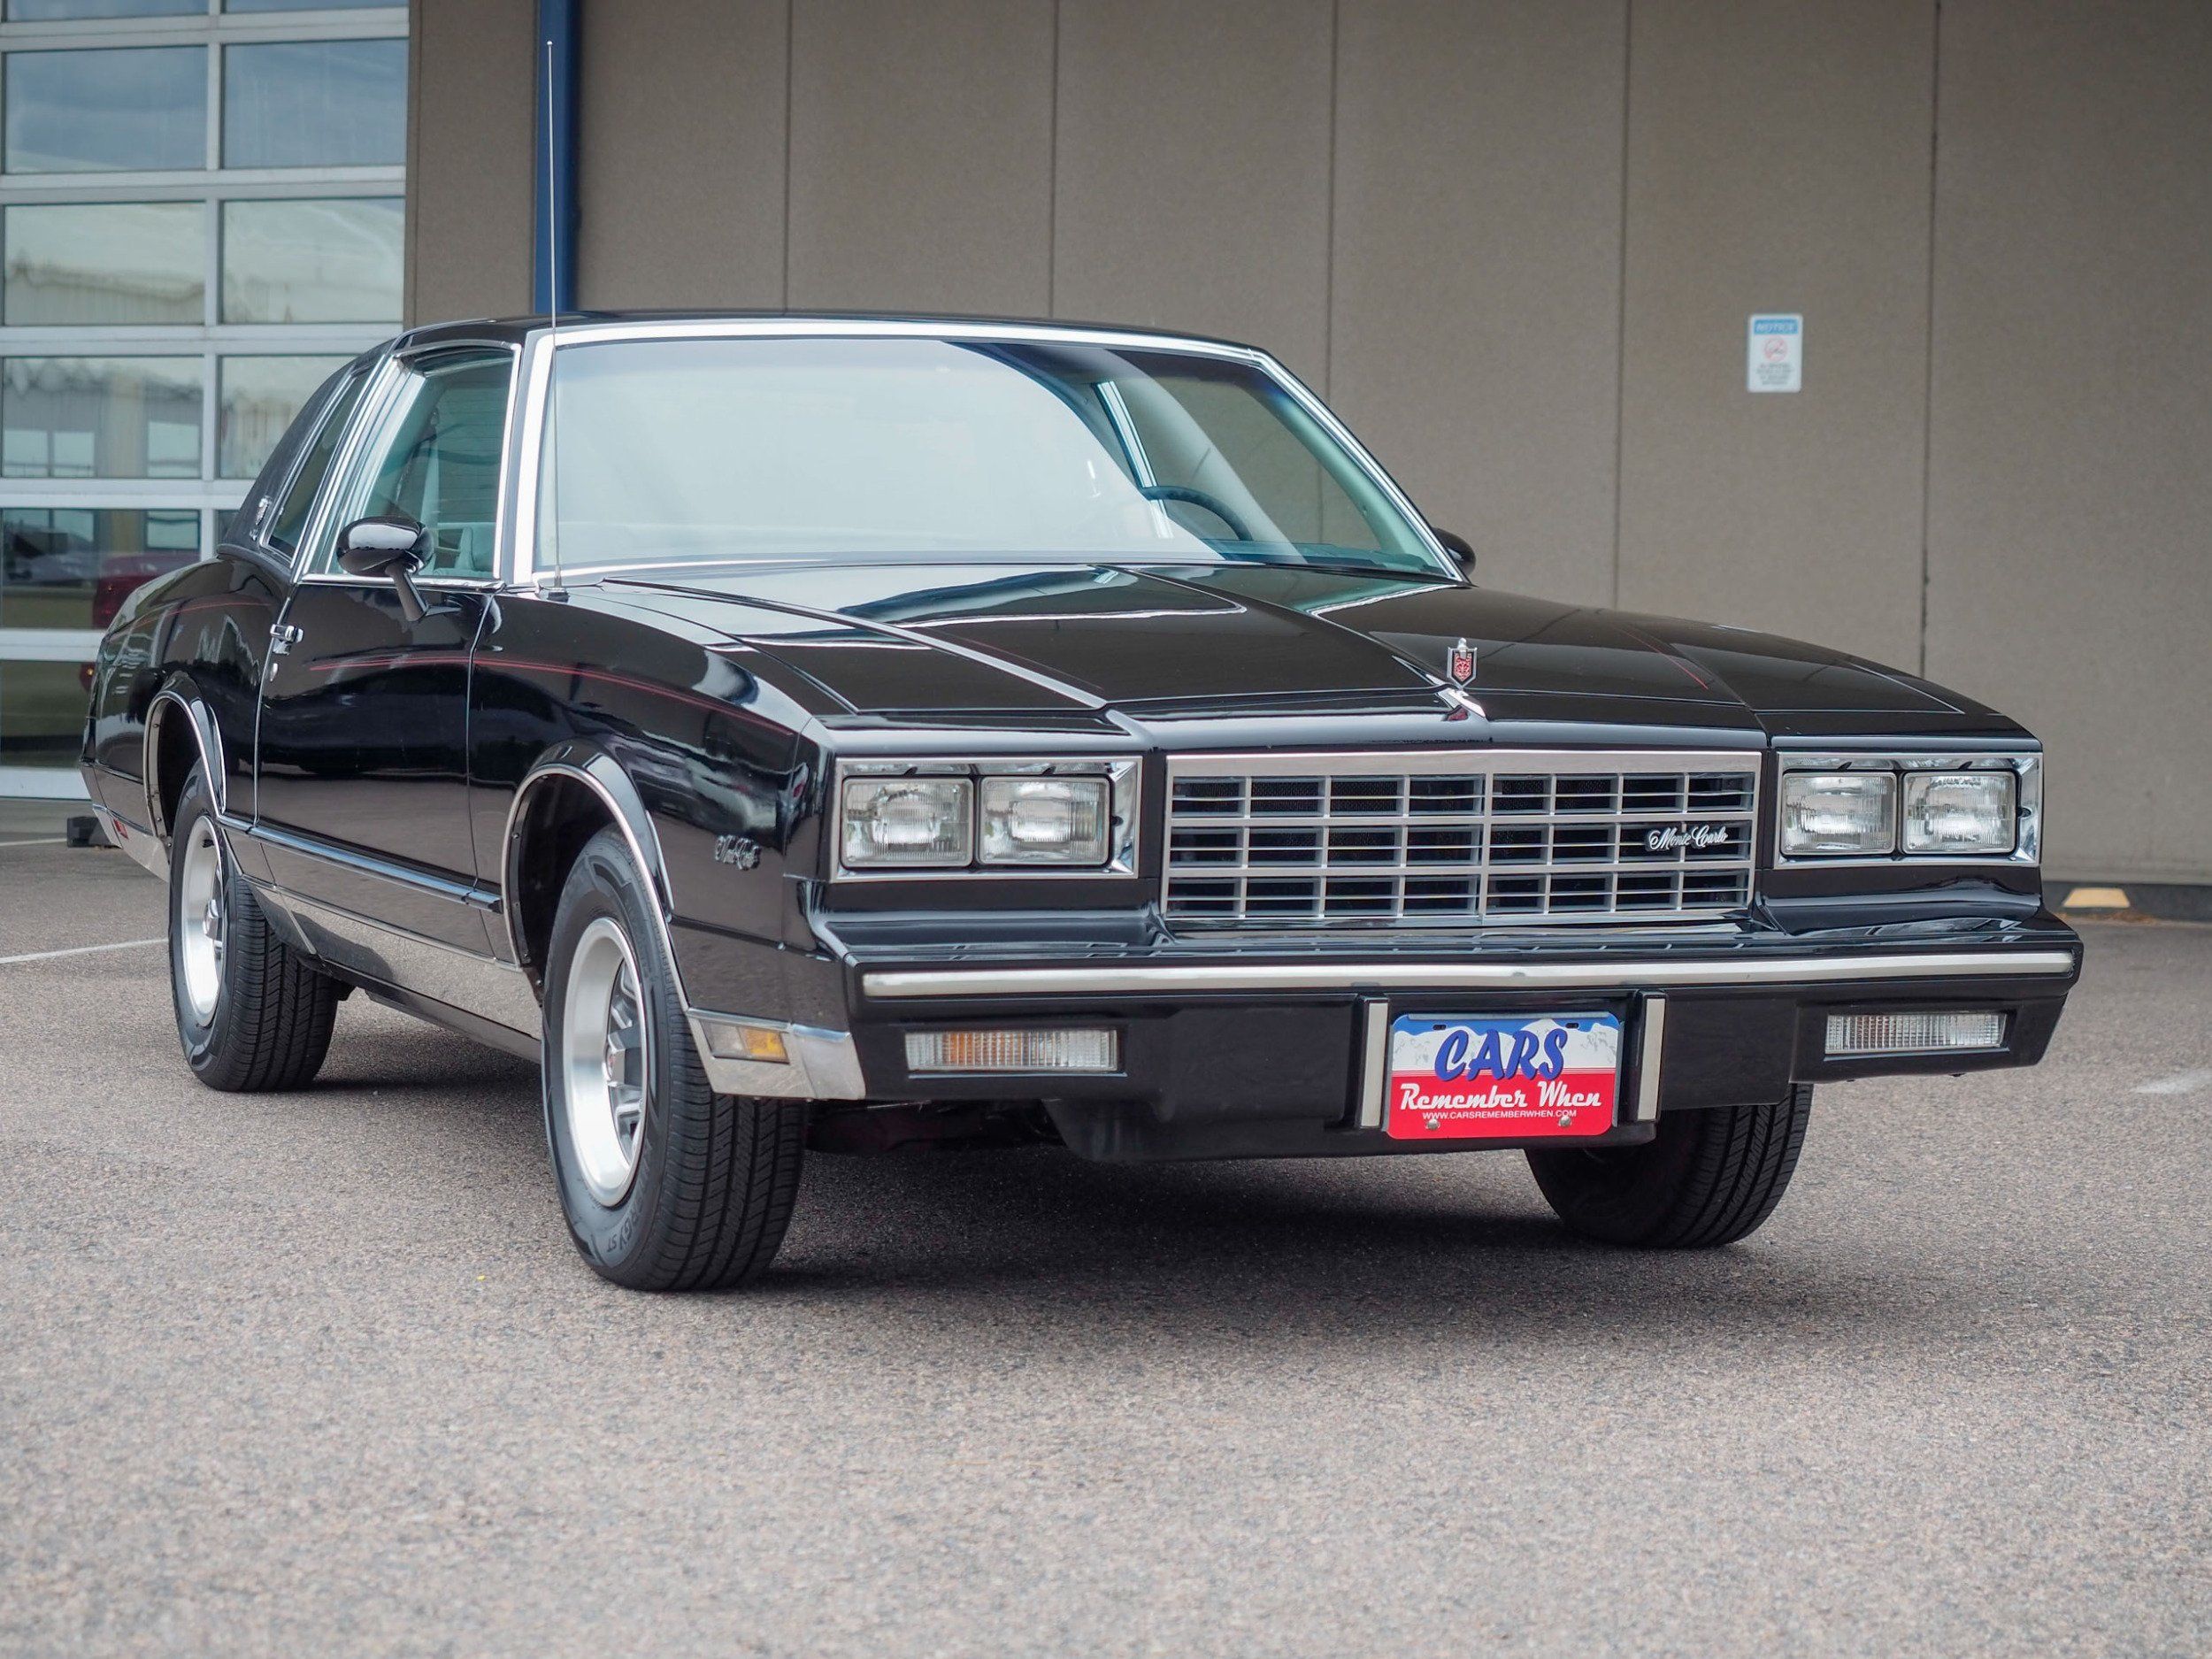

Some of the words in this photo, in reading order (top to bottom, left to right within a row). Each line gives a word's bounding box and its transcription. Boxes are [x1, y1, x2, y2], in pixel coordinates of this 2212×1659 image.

[1648, 826, 1692, 850] Monte
[1692, 825, 1729, 848] Carlo
[1434, 1028, 1568, 1081] CARS
[1400, 1083, 1528, 1110] Remember
[1537, 1080, 1602, 1108] When
[1422, 1109, 1577, 1120] WWW.CARSREMEMBERWHEN.COM
